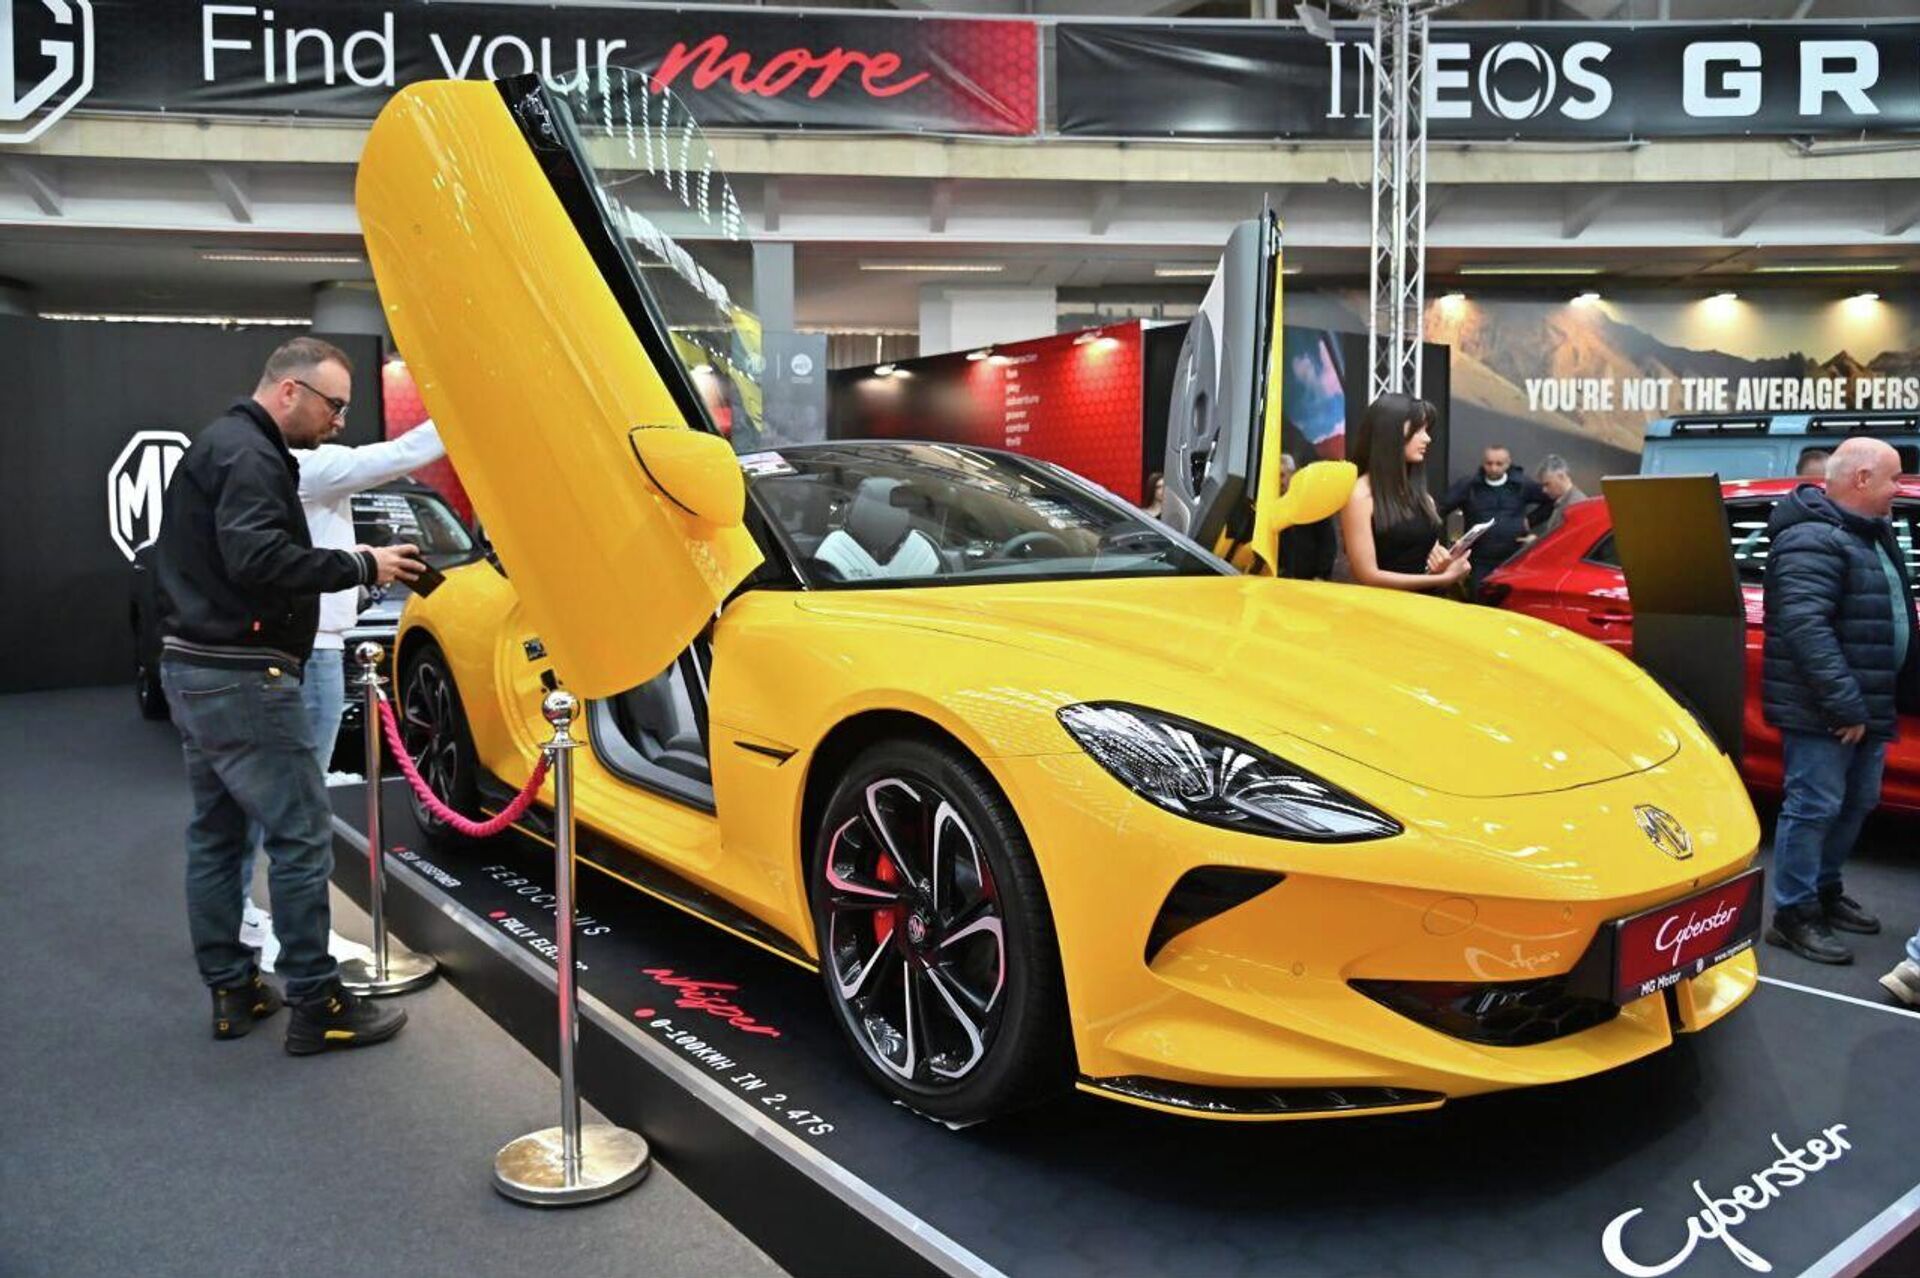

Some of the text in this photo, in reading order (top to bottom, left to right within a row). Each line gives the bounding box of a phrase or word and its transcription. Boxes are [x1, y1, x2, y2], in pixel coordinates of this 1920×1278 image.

[203, 4, 931, 98] Find your more
[1325, 41, 1613, 120] INEOS
[1525, 377, 1920, 412] YOU'RE NOT THE AVERAGE PERS
[481, 865, 611, 936] FEROCIUS
[1655, 900, 1738, 967] Cyberster
[1640, 971, 1682, 997] MG Motor
[730, 1072, 767, 1092] IN
[1601, 1123, 1852, 1278] Cyberster
